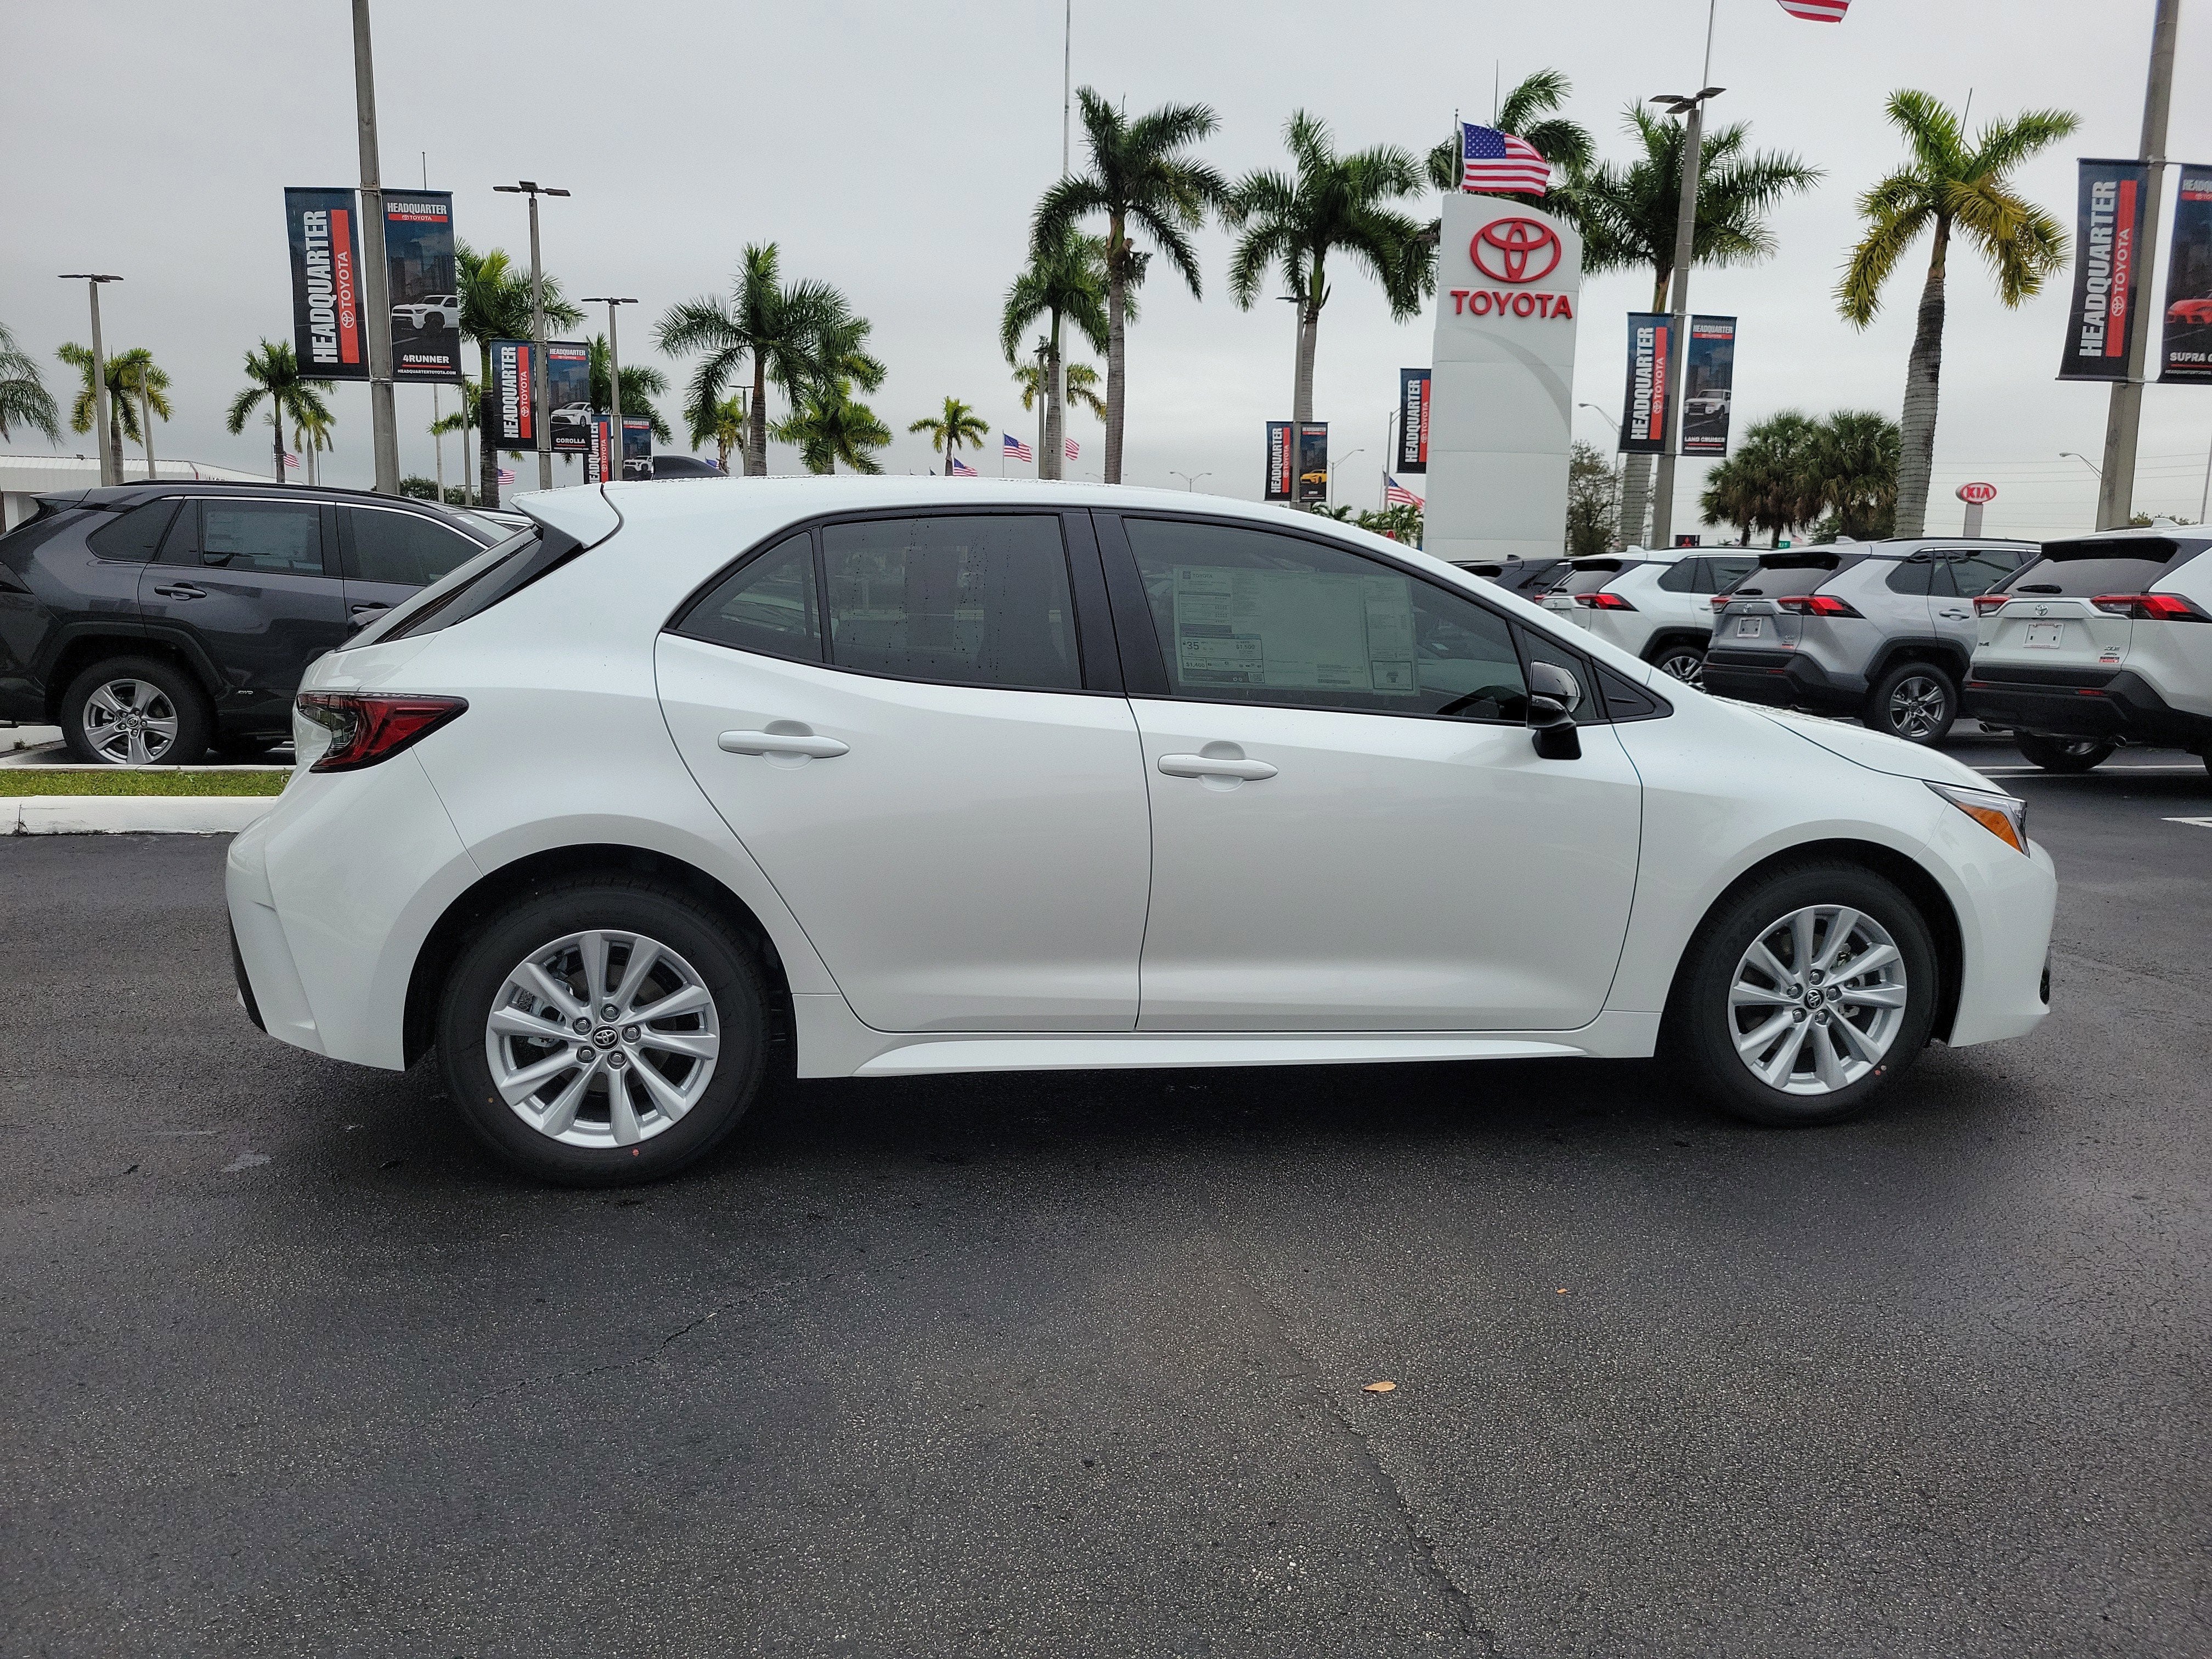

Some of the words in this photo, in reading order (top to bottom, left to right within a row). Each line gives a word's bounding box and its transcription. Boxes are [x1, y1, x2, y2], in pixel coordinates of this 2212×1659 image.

[387, 202, 447, 215] HEADQUARTER
[338, 251, 352, 309] TOYOTA
[2079, 180, 2118, 357] HEADQUARTER
[2114, 228, 2131, 292] TOYOTA
[304, 211, 338, 363] HEADQUARTER
[1450, 290, 1573, 319] TOYOTA
[403, 354, 449, 364] 4RUNNER
[1654, 357, 1665, 399] TOYOTA
[2169, 352, 2205, 362] SUPRA
[501, 346, 519, 438] HEADQUARTER
[521, 371, 529, 405] TOYOTA
[1630, 327, 1654, 439] HEADQUARTER
[1405, 380, 1421, 462] HEADQUARTER
[1271, 428, 1283, 493] HEADQUARTER
[1967, 487, 1991, 499] KIA
[1186, 641, 1199, 650] 35
